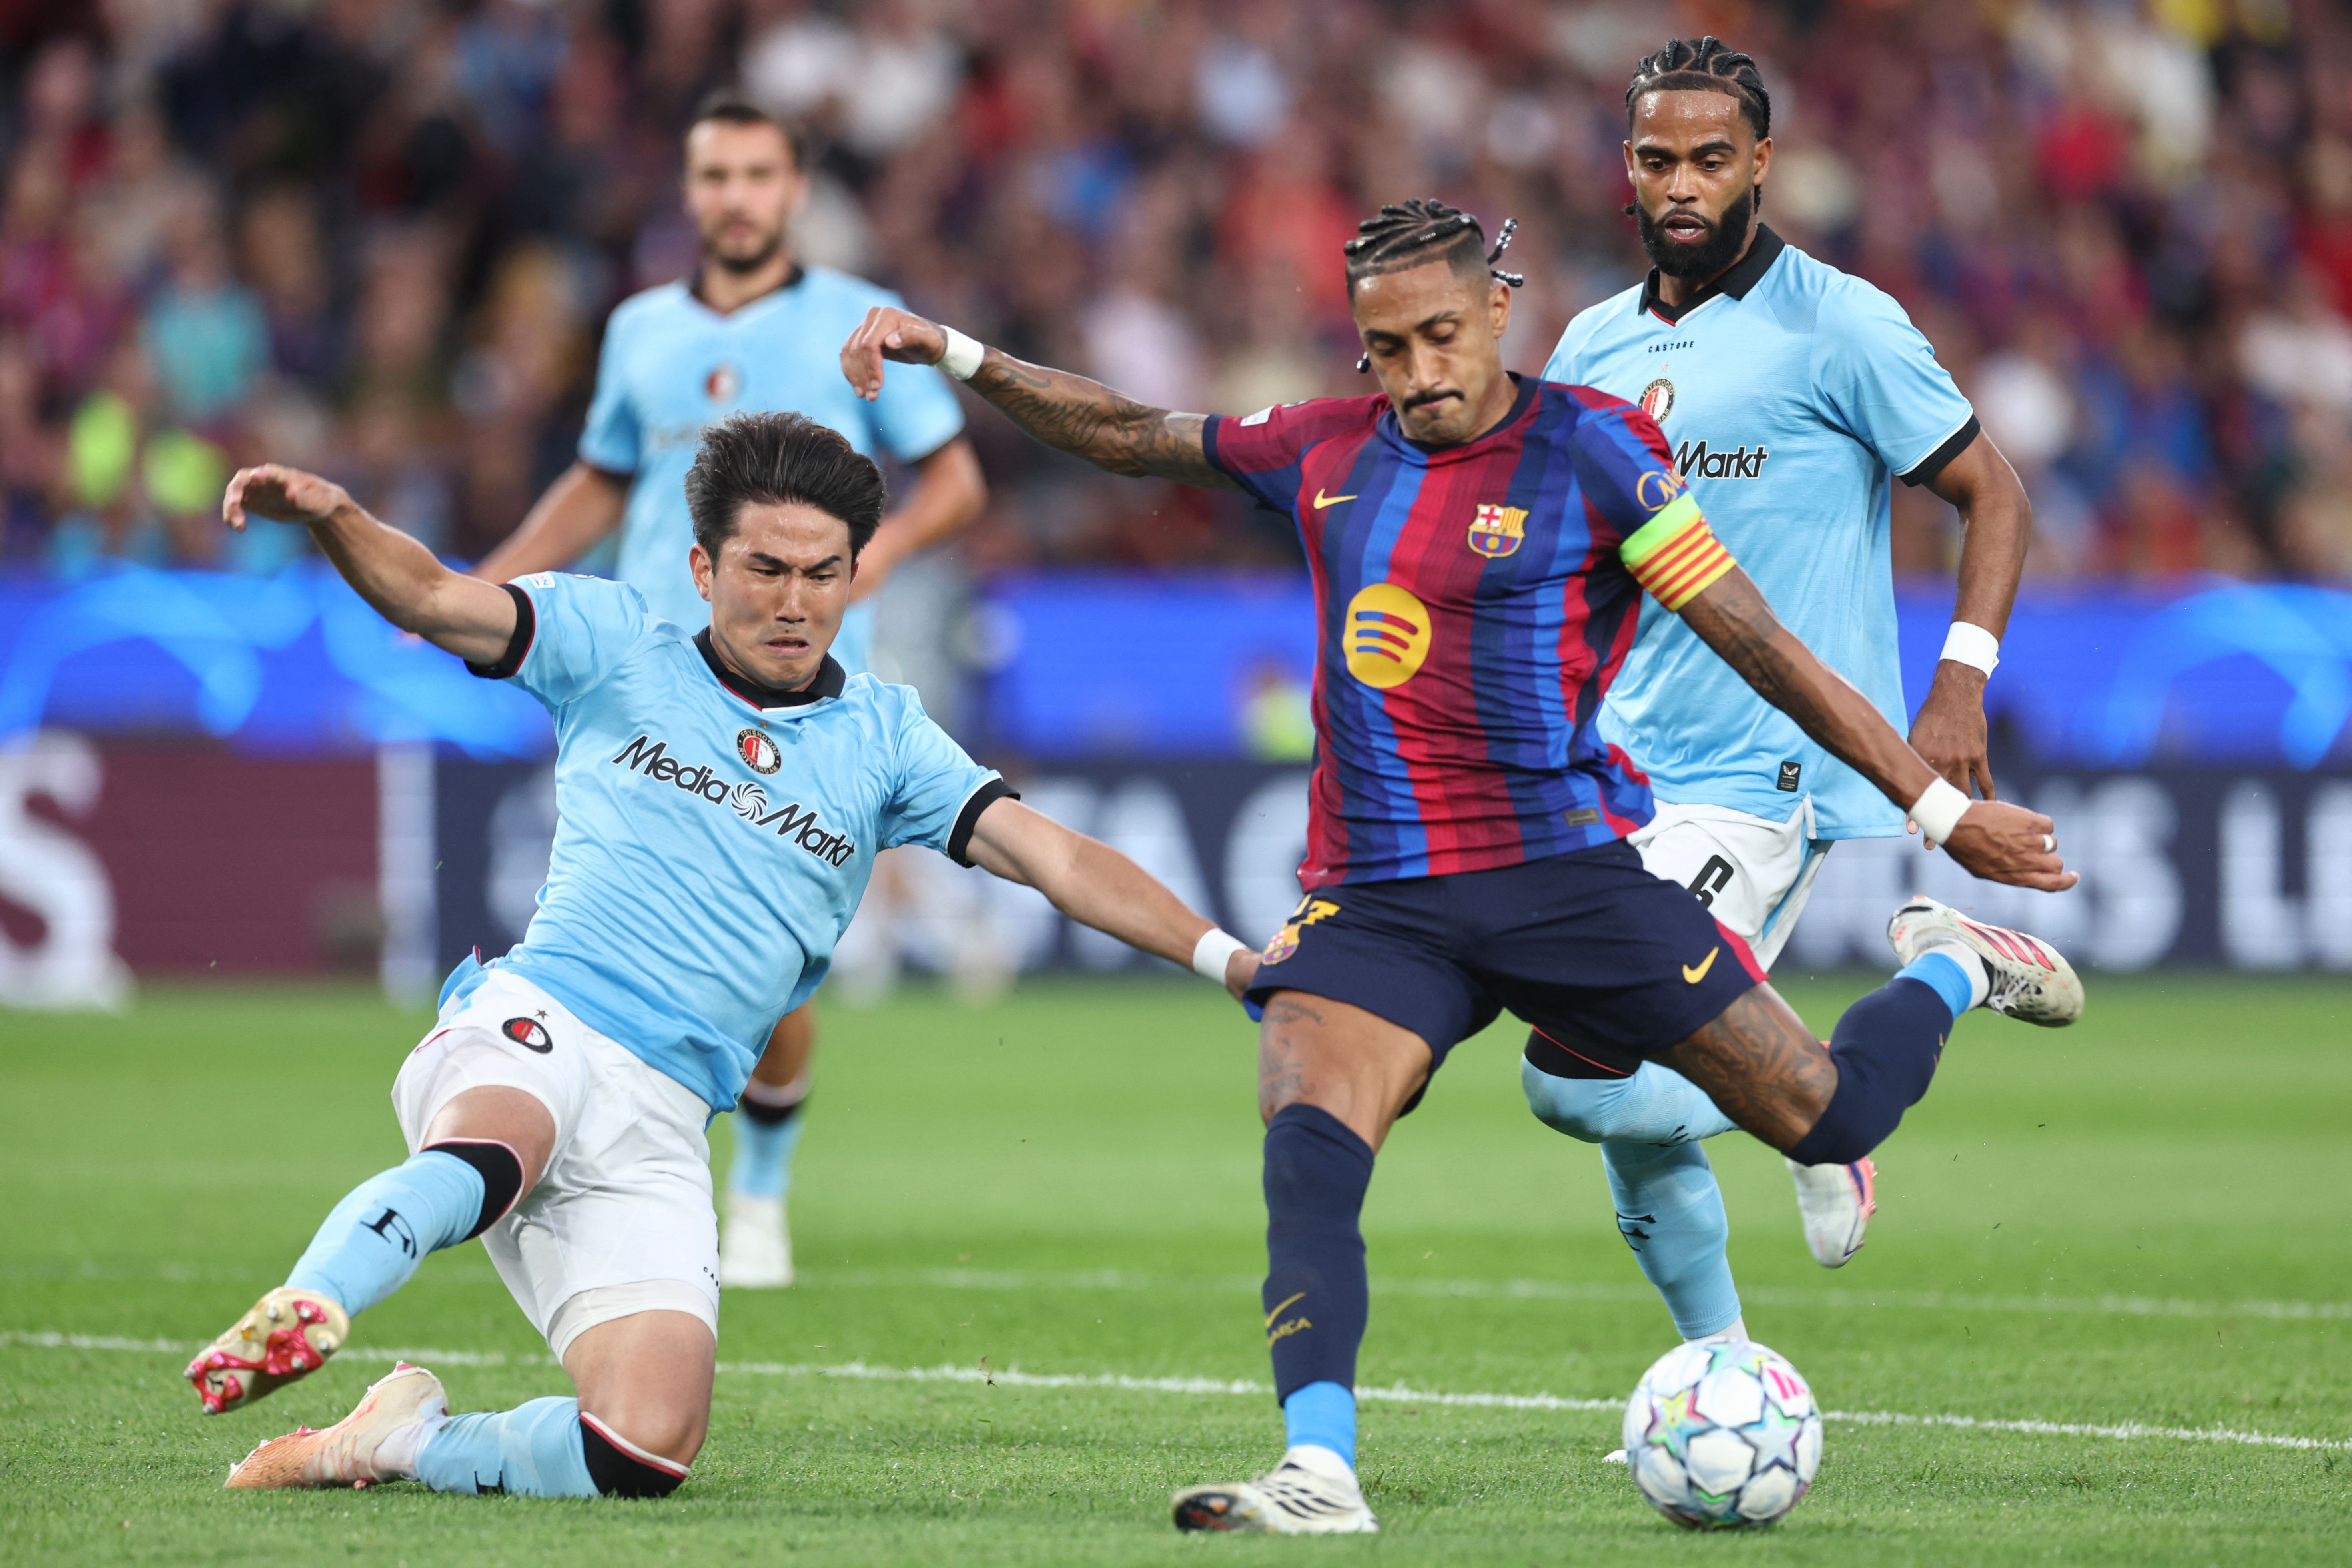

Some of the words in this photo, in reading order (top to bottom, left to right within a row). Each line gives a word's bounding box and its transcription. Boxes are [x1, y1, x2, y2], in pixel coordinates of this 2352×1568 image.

[1648, 341, 1694, 353] CASTORE
[1642, 379, 1674, 398] FEYENOORD
[1674, 441, 1768, 479] Markt
[740, 729, 780, 757] FEYENOORD
[612, 735, 730, 804] Media
[755, 803, 855, 868] Markt
